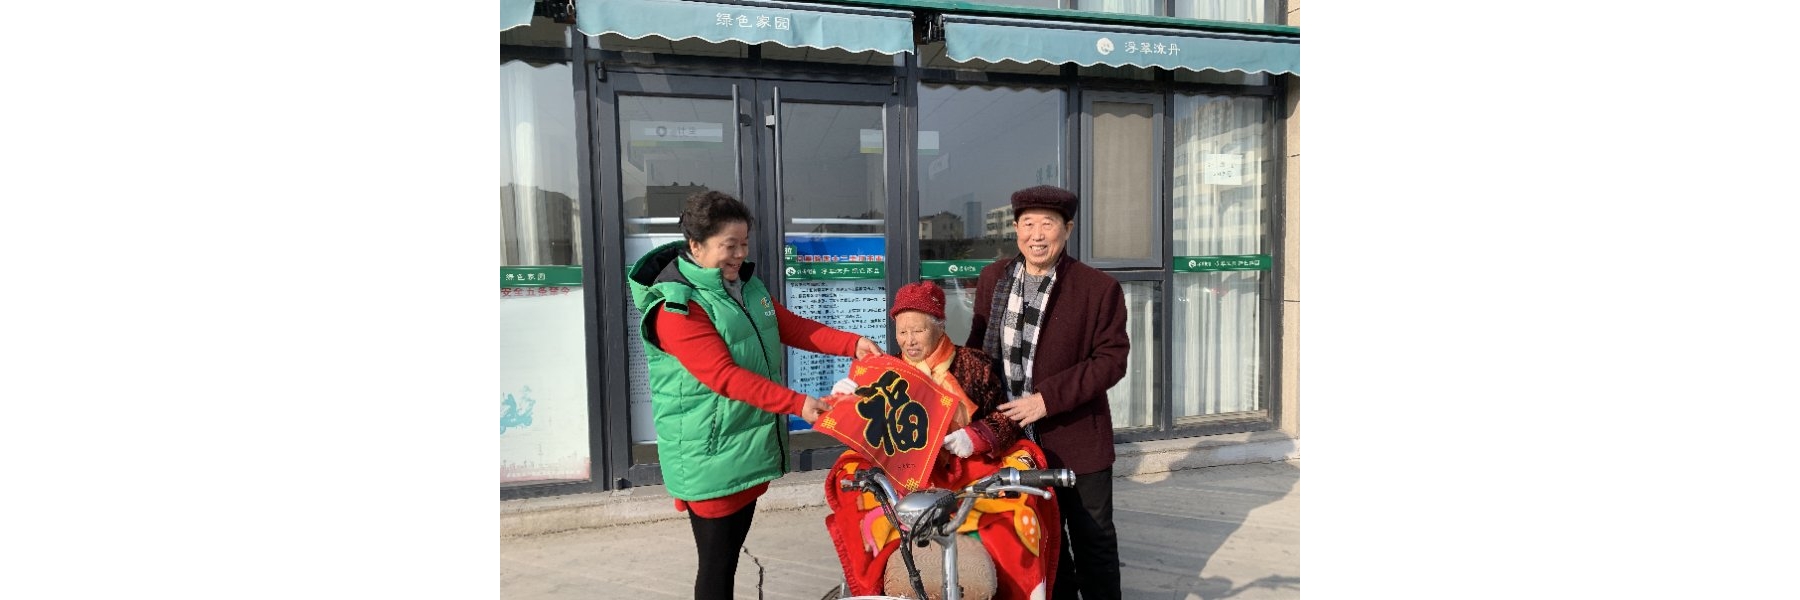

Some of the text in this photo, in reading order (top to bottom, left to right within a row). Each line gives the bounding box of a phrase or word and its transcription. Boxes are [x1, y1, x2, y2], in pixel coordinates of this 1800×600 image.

[715, 12, 790, 31] 绿色家园
[505, 272, 546, 281] 绿色家园
[854, 370, 930, 456] 福
